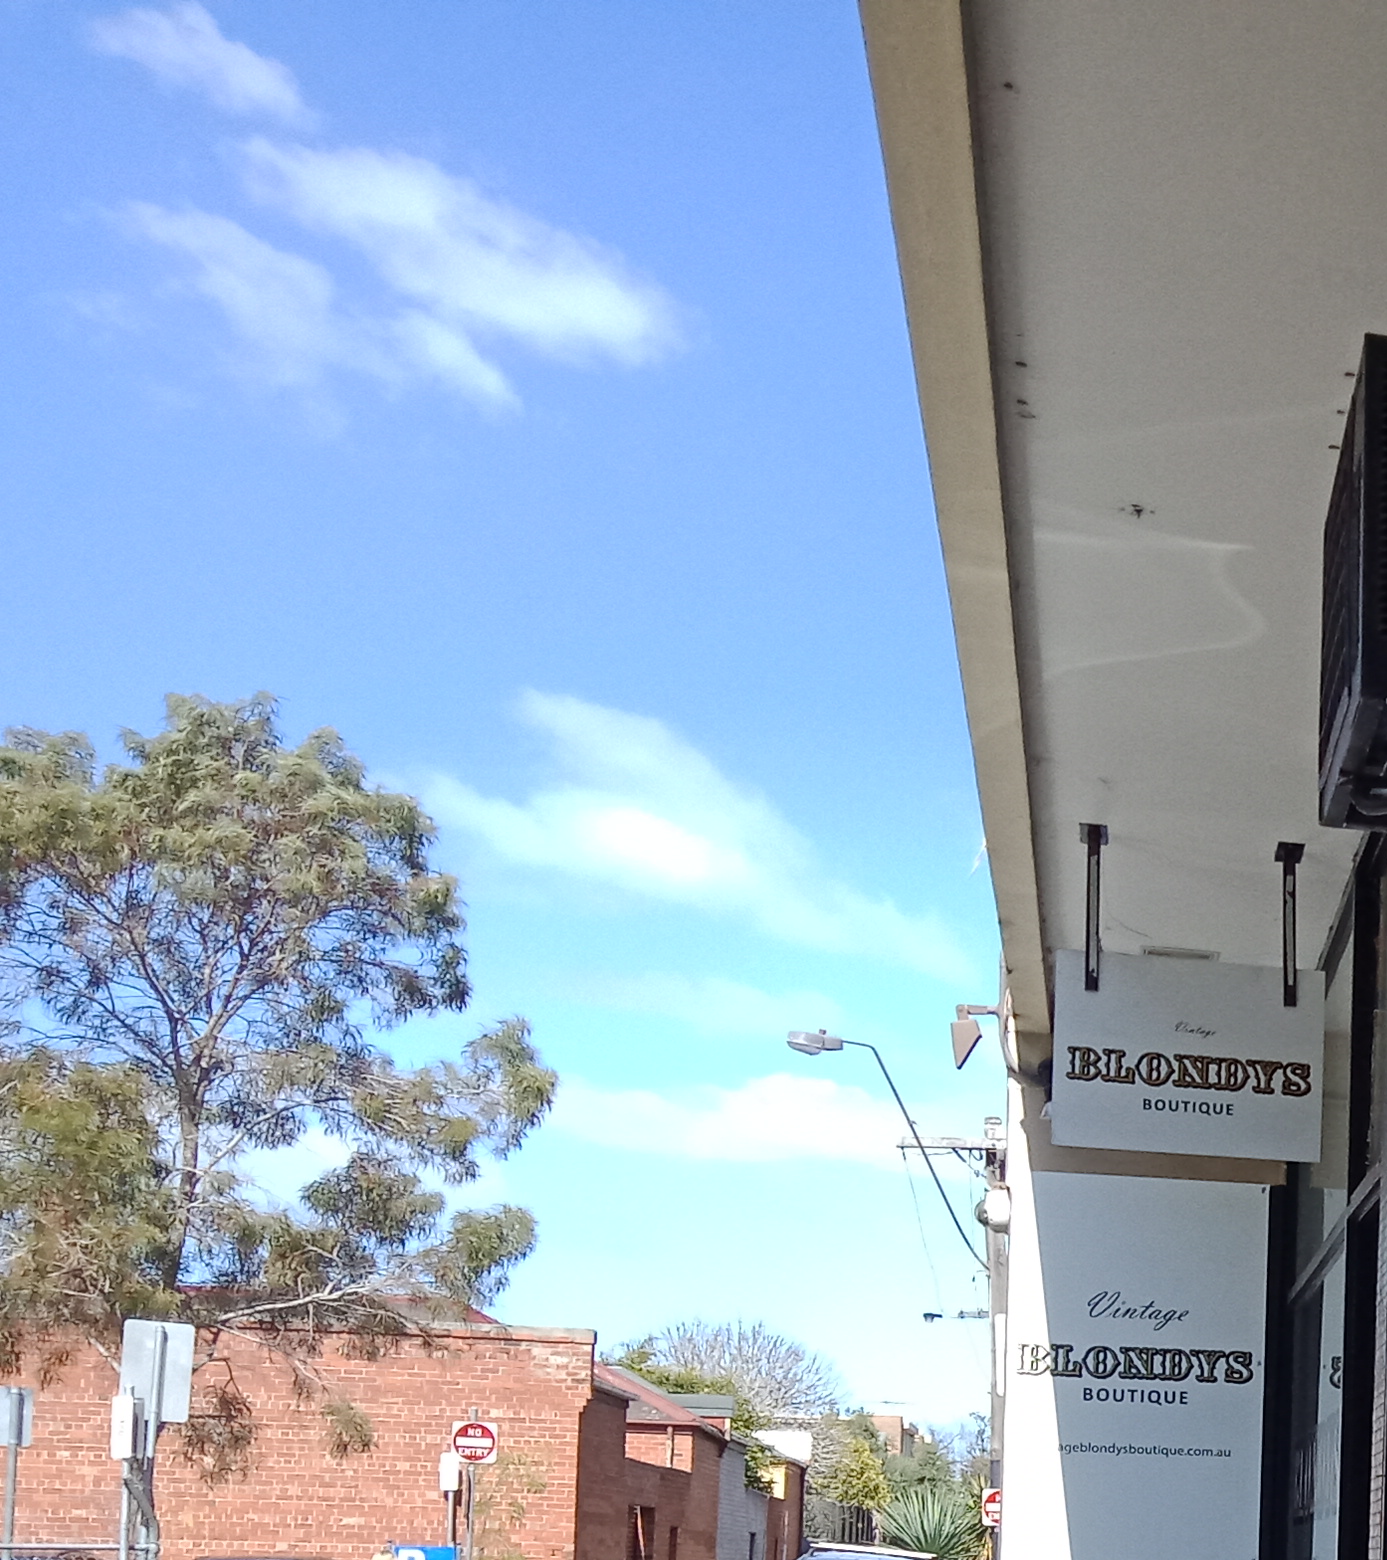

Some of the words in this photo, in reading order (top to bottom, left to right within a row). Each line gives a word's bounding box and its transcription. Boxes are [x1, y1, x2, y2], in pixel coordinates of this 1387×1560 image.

[1174, 1020, 1216, 1039] Vintage
[1066, 1045, 1312, 1097] BLONDYS
[1143, 1098, 1234, 1116] BOUTIQUE
[1087, 1290, 1190, 1331] Vintage
[1016, 1342, 1254, 1384] BLONDYS
[1083, 1386, 1189, 1406] BOUTIQUE
[467, 1428, 483, 1437] NO
[458, 1447, 490, 1457] ENTRY
